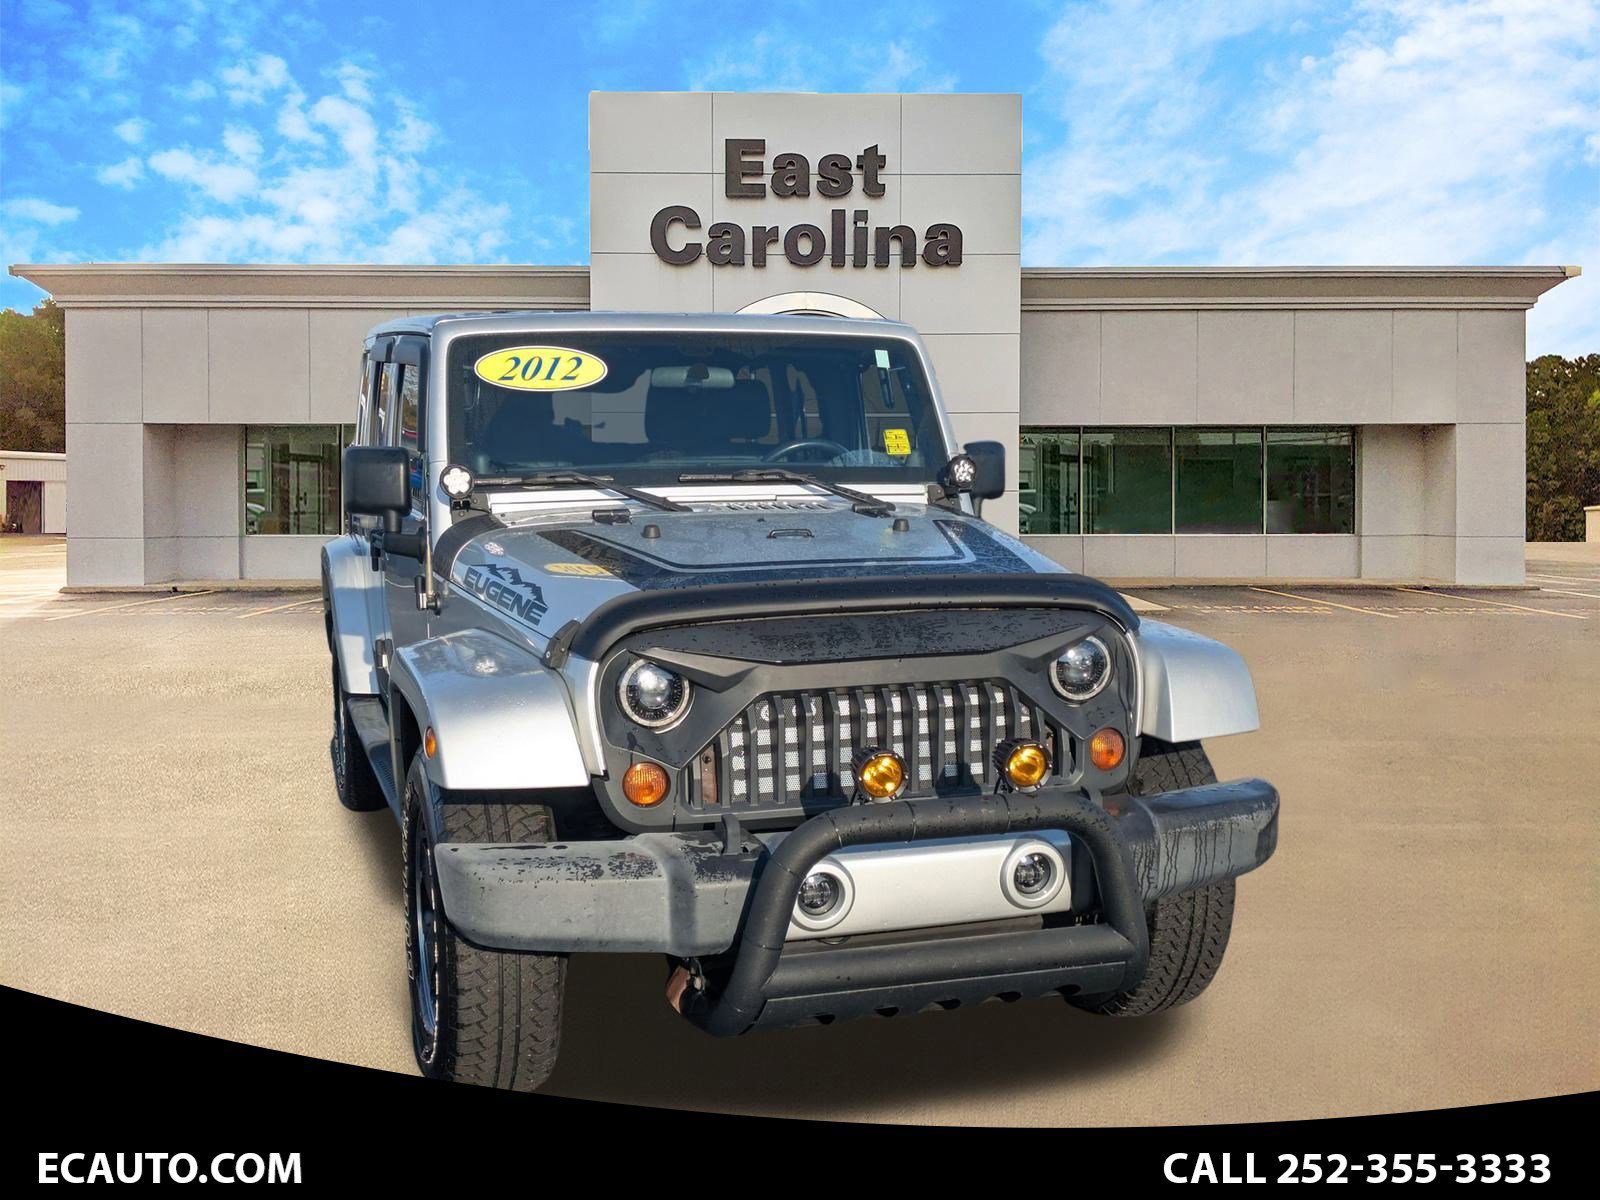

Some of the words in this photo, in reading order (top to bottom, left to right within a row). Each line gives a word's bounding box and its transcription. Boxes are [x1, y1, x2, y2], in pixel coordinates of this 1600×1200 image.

[725, 138, 887, 198] East
[650, 205, 963, 267] Carolina
[497, 355, 583, 382] 2012
[463, 566, 548, 626] EUGENE
